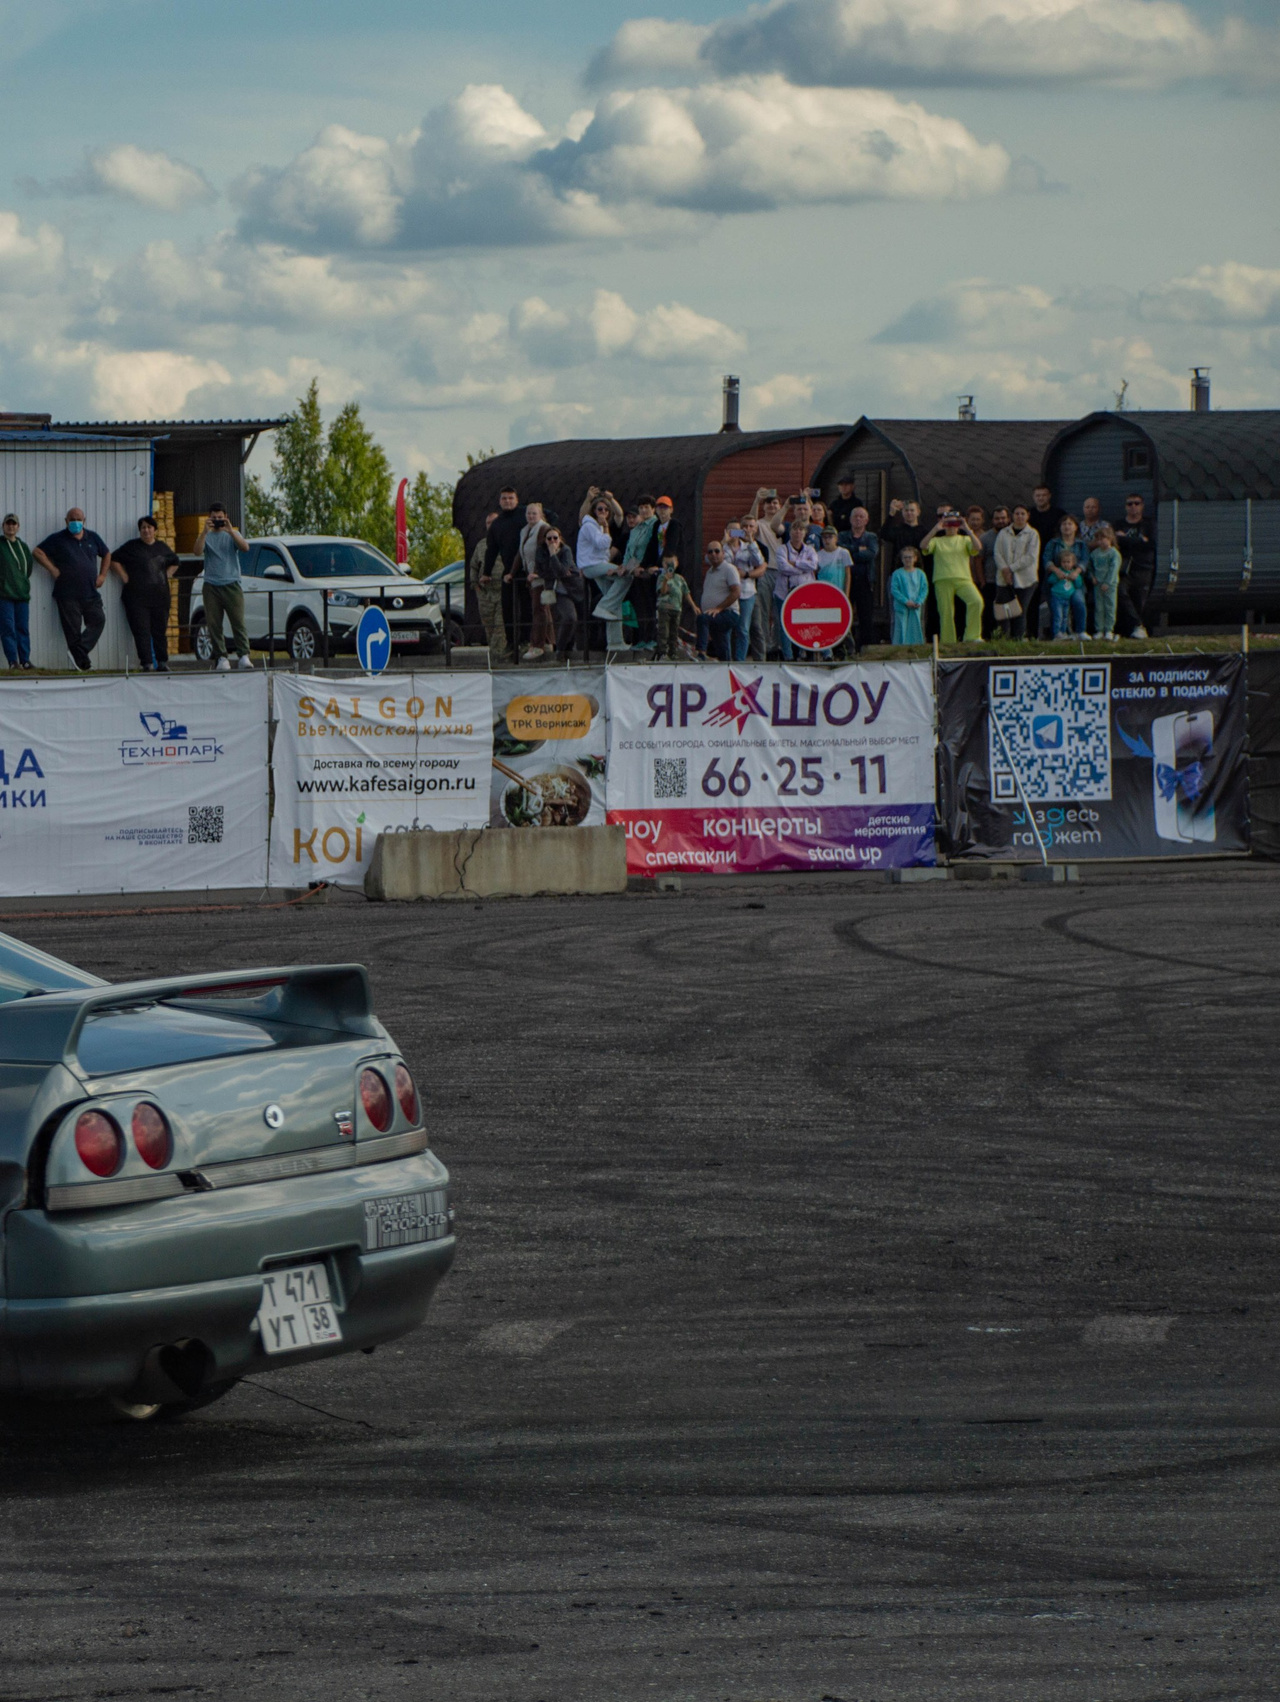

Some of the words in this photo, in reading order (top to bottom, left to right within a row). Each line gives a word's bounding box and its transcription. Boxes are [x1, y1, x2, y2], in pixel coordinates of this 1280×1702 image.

[1128, 672, 1145, 683] ЗА
[1148, 669, 1210, 683] ПОДПИСКУ
[1111, 686, 1156, 699] СТЕКЛО
[1159, 687, 1169, 697] В
[1172, 684, 1229, 698] ПОДАРОК
[523, 703, 575, 715] ФУДКОРТ
[297, 721, 417, 739] Вьетнамская
[422, 722, 474, 738] кухня
[511, 718, 533, 729] ТРК
[535, 717, 587, 730] Вернисаж
[618, 740, 633, 750] ВСЕ
[634, 739, 671, 750] СОБЫТИЯ
[707, 738, 767, 749] ОФИЦИАЛЬНЫЕ
[800, 735, 868, 748] МАКСИМАЛЬНЫЙ
[869, 736, 898, 746] ВЫБОР
[898, 735, 920, 745] МЕСТ
[117, 744, 225, 759] ТЕХНОПАРК
[313, 758, 363, 770] Доставка
[365, 760, 381, 769] по
[382, 759, 417, 770] всему
[418, 758, 461, 771] городу
[296, 774, 476, 796] www.kafesaigon.ru
[703, 816, 822, 840] концерты
[868, 814, 910, 827] детские
[854, 824, 927, 839] мероприятия
[645, 848, 738, 866] спектакли
[808, 844, 856, 862] stand
[859, 845, 882, 864] up
[382, 1212, 448, 1233] СКОРОСТЬ
[309, 1306, 332, 1331] 38
